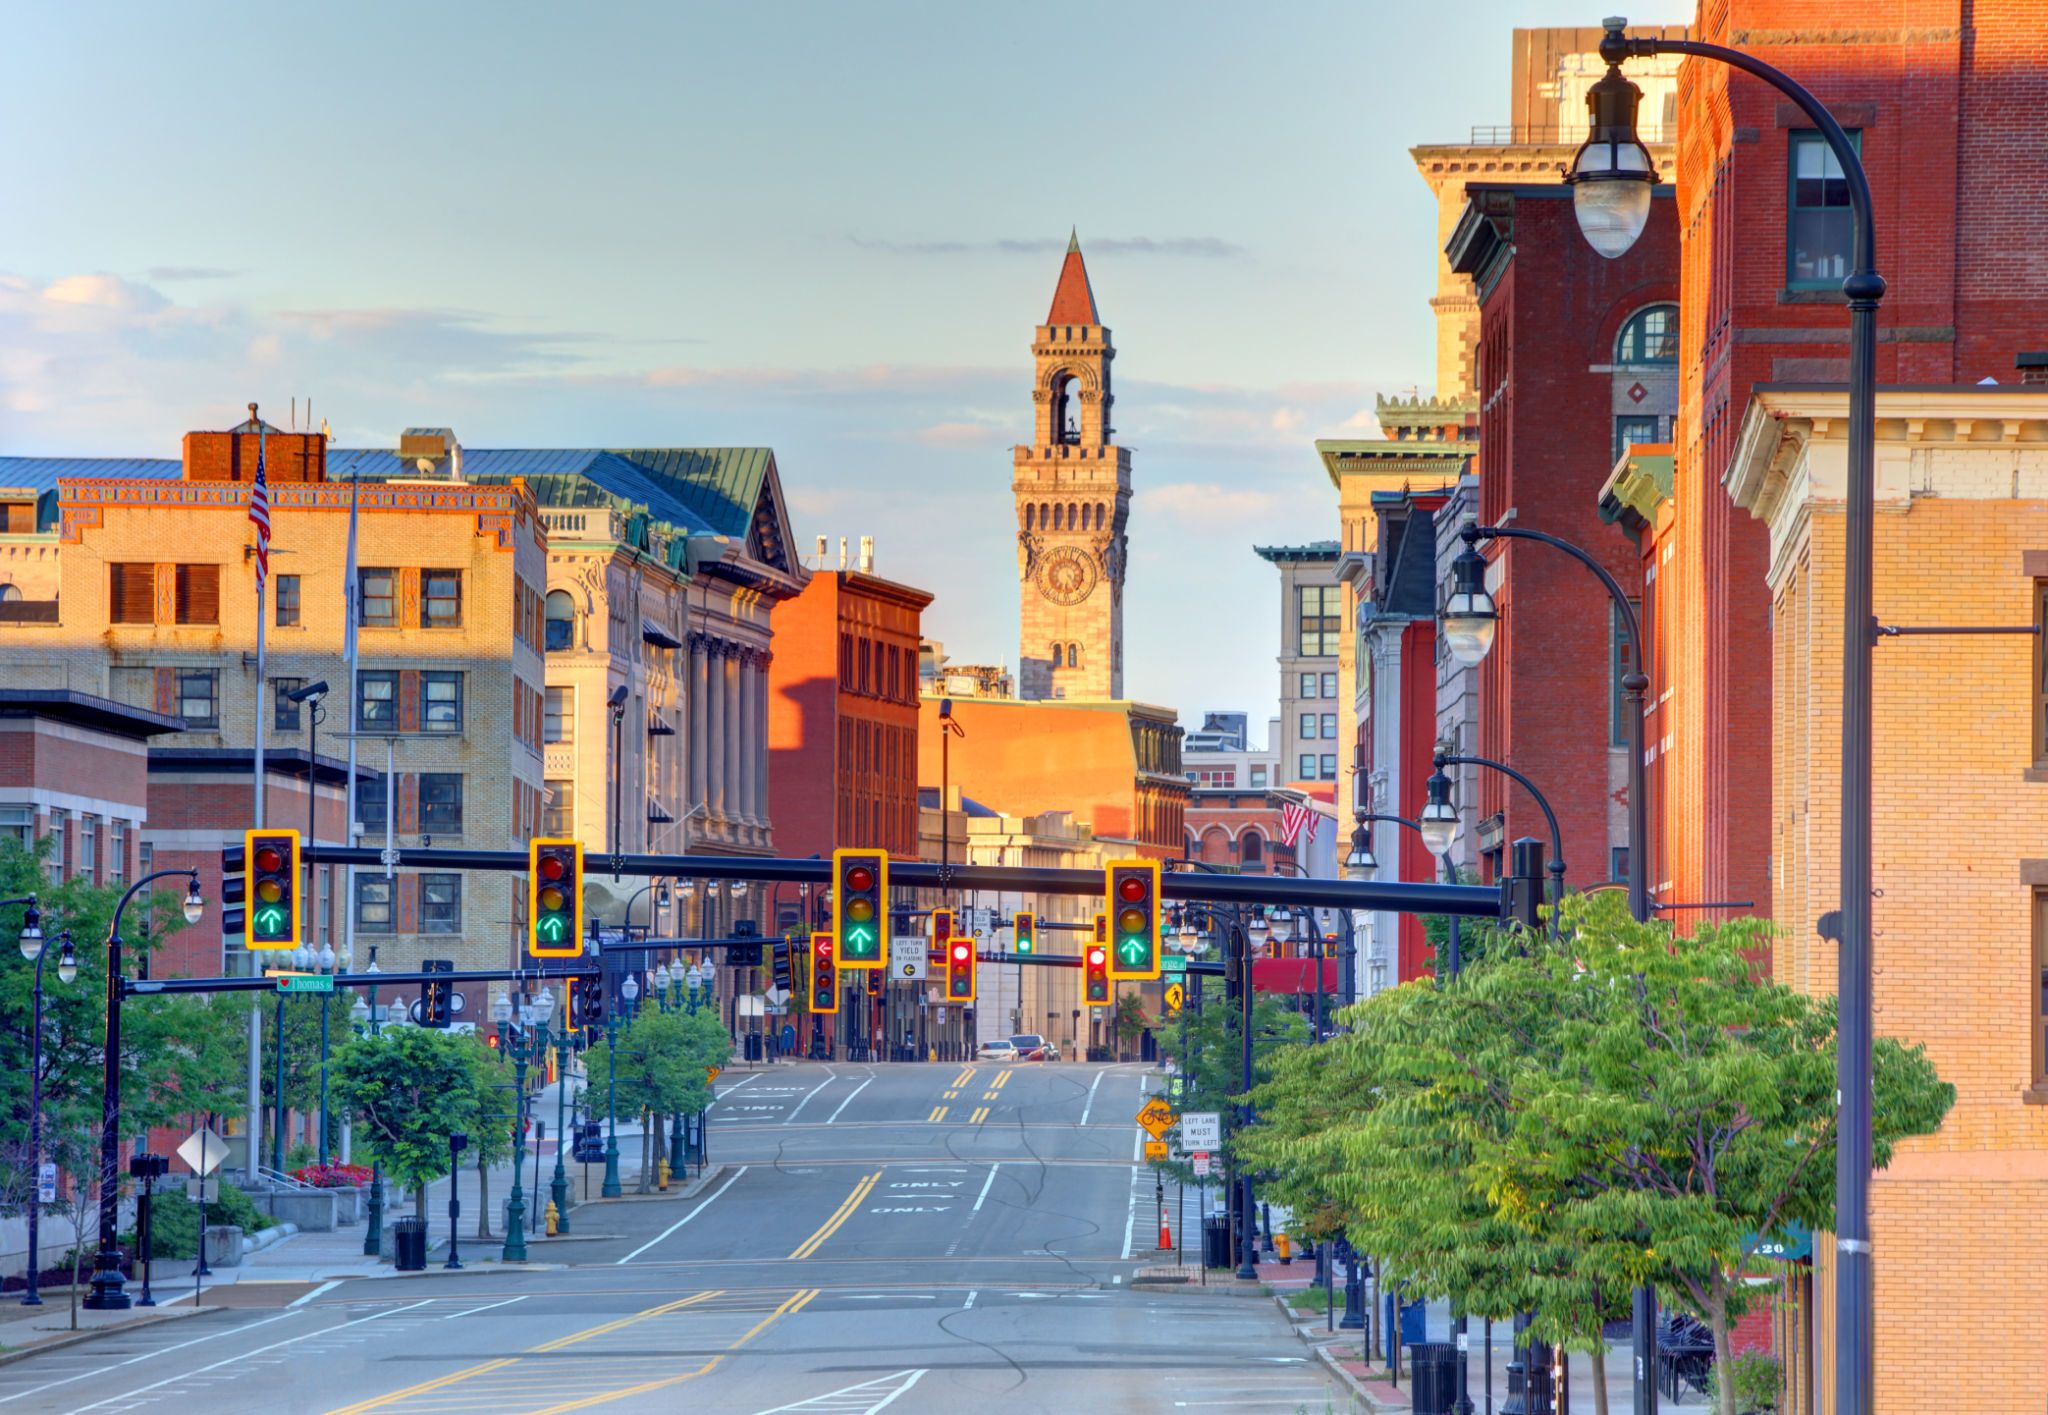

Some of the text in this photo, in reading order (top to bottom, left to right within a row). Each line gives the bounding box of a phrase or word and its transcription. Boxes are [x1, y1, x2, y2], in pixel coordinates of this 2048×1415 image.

[900, 947, 919, 955] YIELD
[291, 977, 325, 990] Thomas
[1190, 1128, 1211, 1136] MUST
[870, 1206, 954, 1214] ONLY
